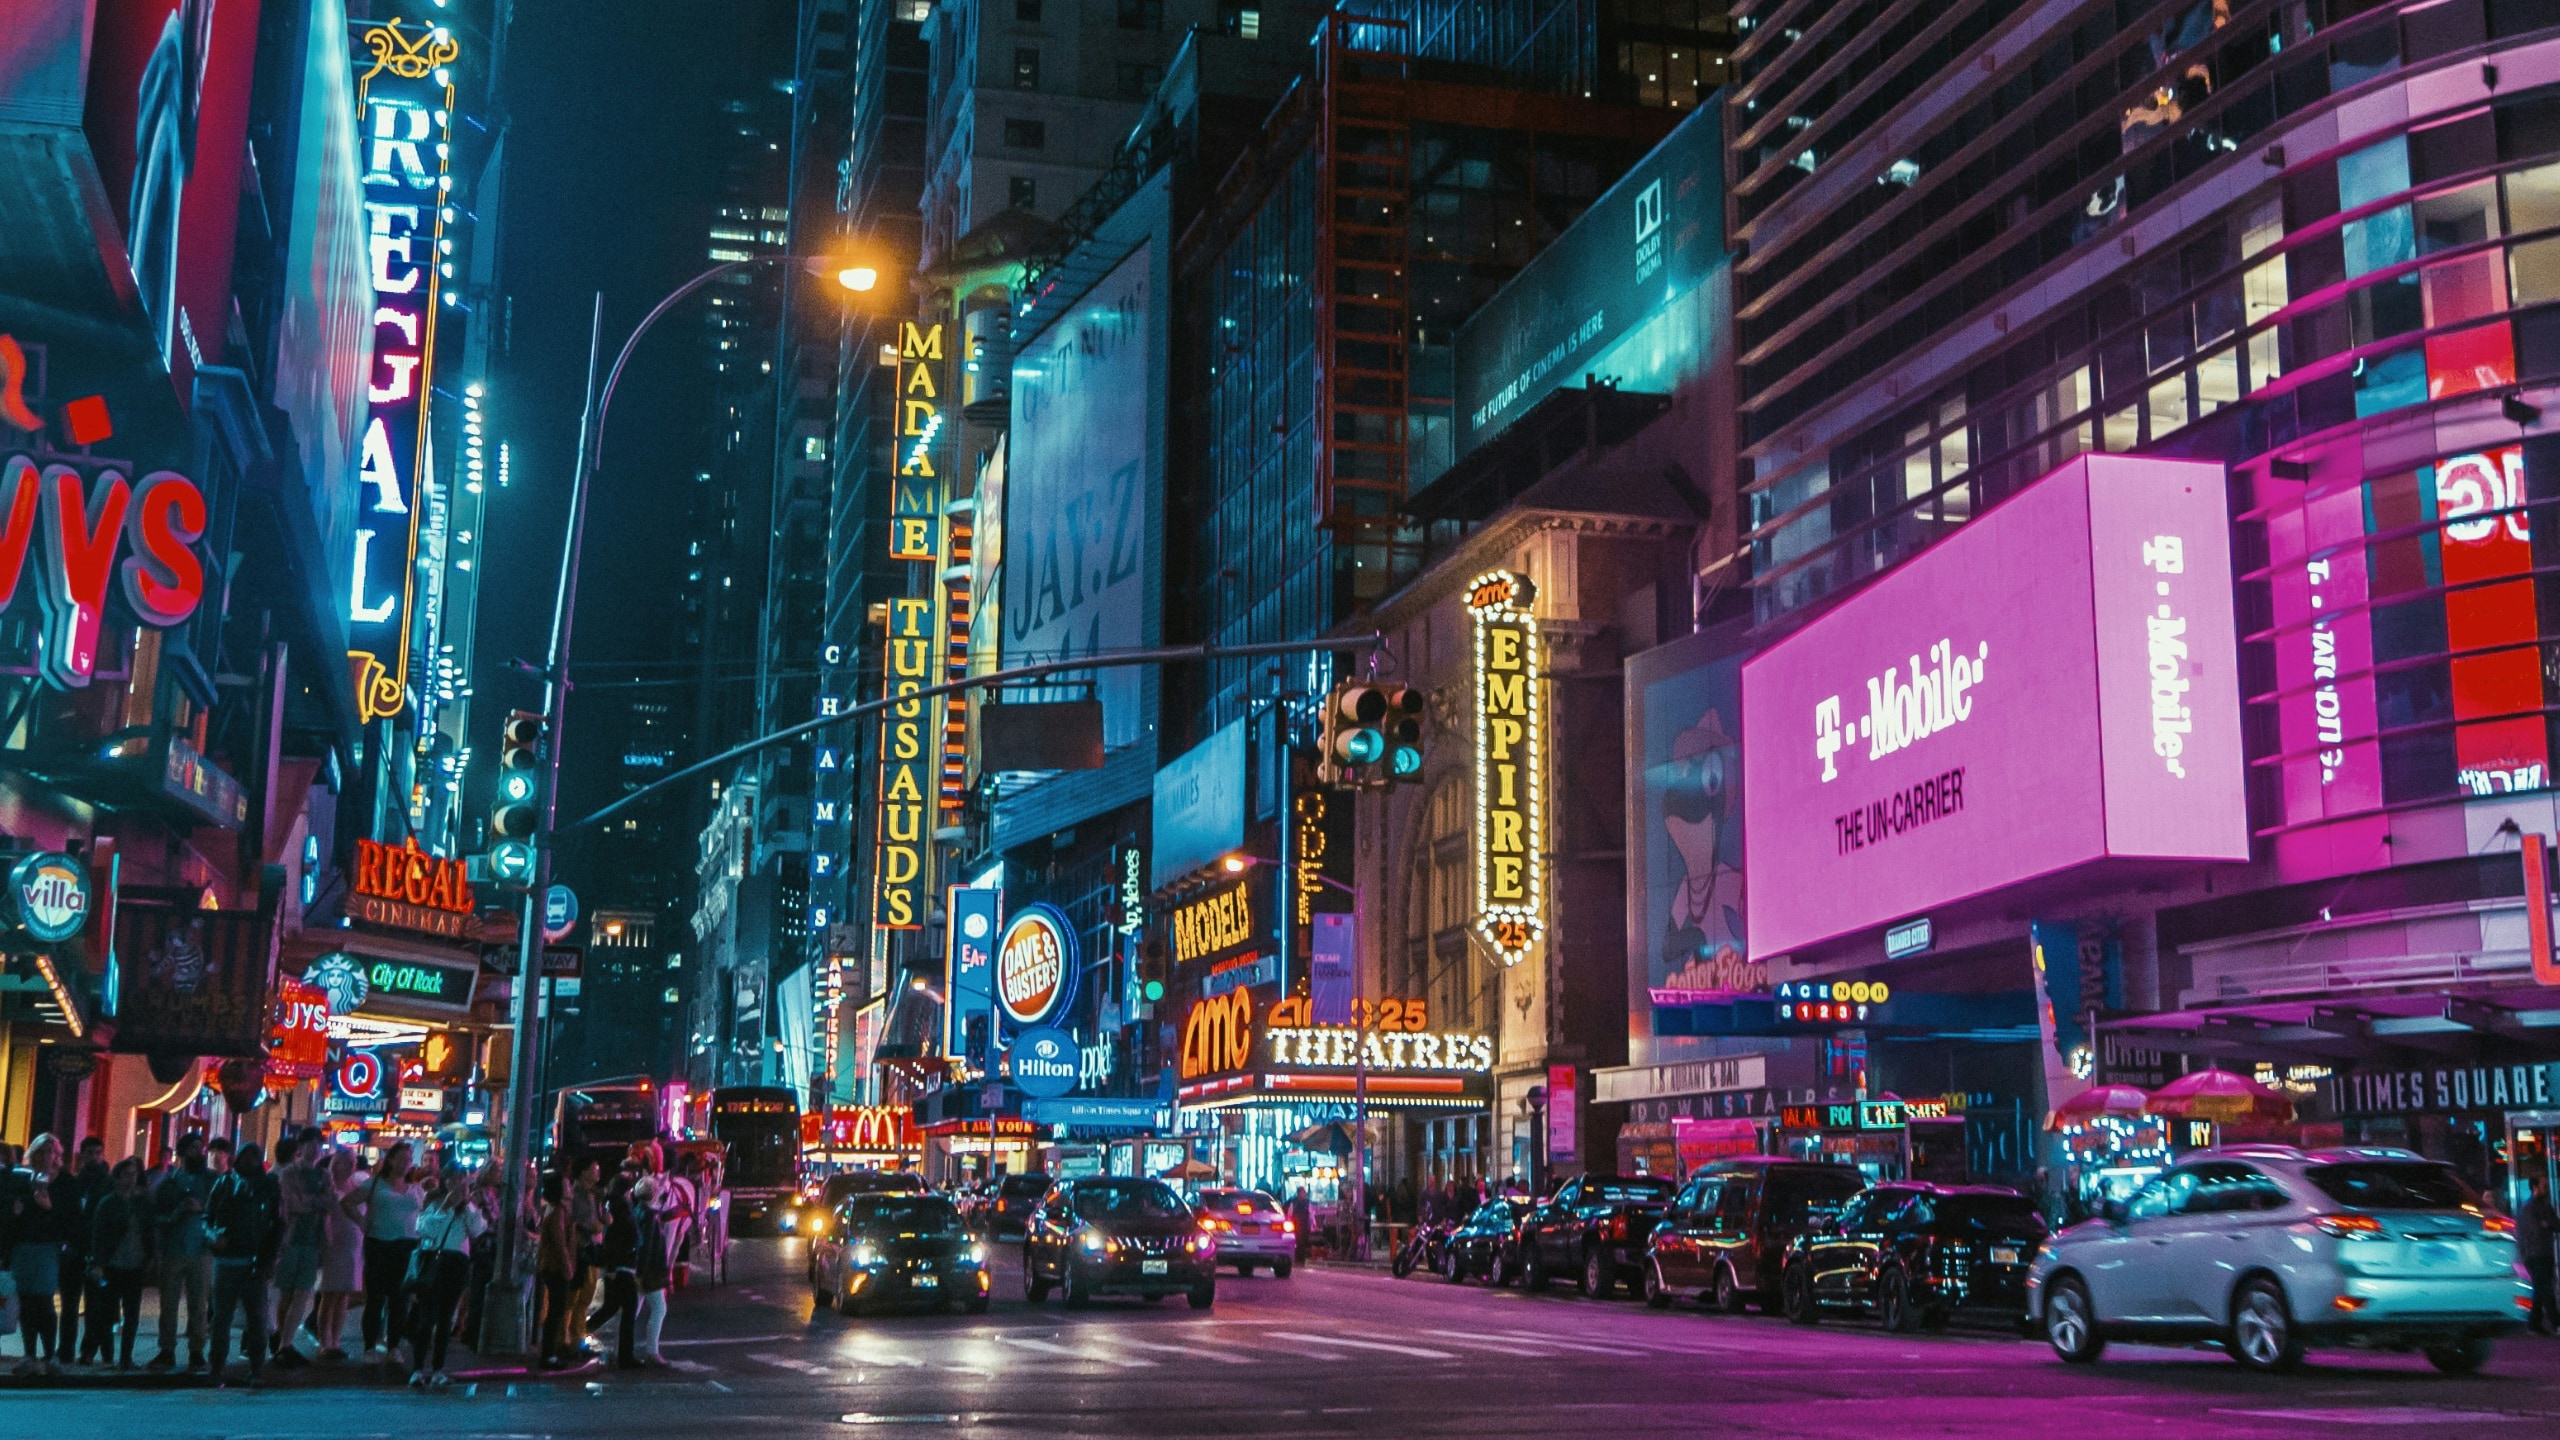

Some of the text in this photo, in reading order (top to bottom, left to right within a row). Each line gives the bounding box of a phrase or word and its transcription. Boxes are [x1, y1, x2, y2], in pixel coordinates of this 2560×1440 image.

[1636, 230, 1661, 267] DOLBY
[1636, 252, 1662, 285] CINEMA
[350, 96, 436, 623] REGAL
[1472, 309, 1604, 432] THE FUTURE OF CINEMA IS HERE
[884, 321, 943, 925] MADAME TUSSAUD'S
[814, 645, 840, 928] CHAMPS
[1487, 629, 1527, 900] EMPIRE
[1835, 808, 1864, 855] THE
[22, 880, 85, 913] villa
[356, 837, 476, 914] REGAL
[366, 899, 461, 936] CINEMAS
[1499, 921, 1526, 948] 25
[1005, 931, 1056, 979] DAVE &
[371, 963, 443, 994] City Of Rock
[1006, 958, 1057, 1003] BUSTER'S
[1379, 998, 1427, 1032] 25
[1019, 1059, 1073, 1077] Hilton
[1266, 1028, 1492, 1072] THEATRES
[338, 1051, 382, 1099] Q
[2352, 1072, 2424, 1111] TIMES
[2435, 1064, 2549, 1110] SQUARE
[323, 1097, 389, 1112] RESTAURANT
[1636, 1086, 1839, 1123] DOWNSTAIRS
